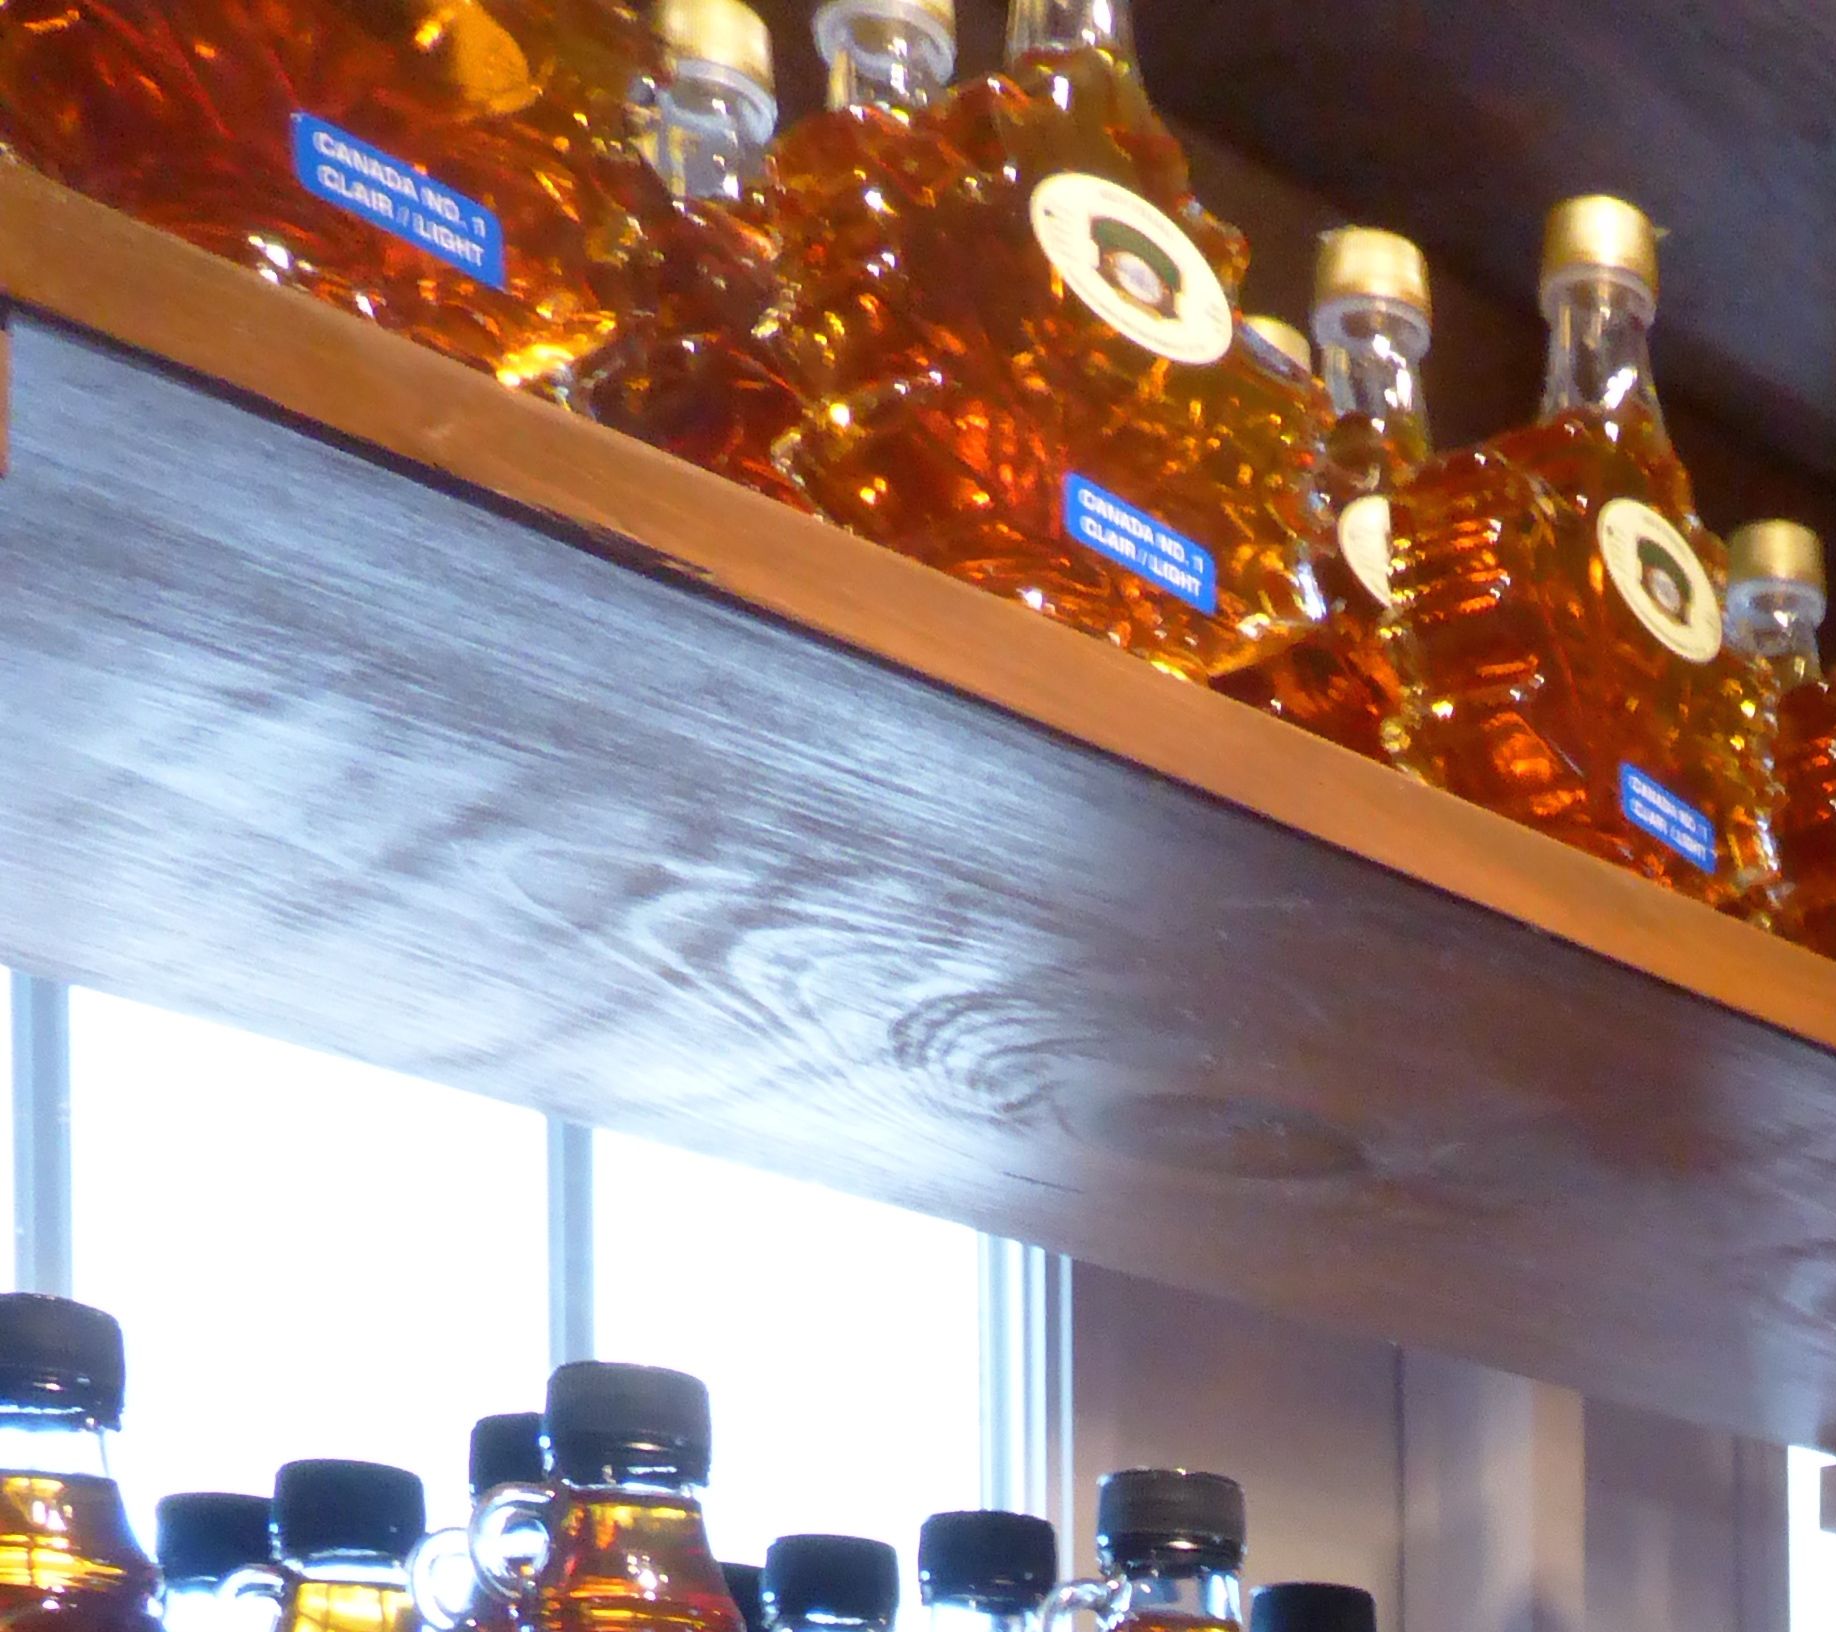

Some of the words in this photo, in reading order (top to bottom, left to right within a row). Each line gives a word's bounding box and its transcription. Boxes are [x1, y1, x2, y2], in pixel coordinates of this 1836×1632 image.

[313, 131, 419, 202] CANADA
[472, 216, 486, 238] 1
[317, 164, 395, 220] CLAIR
[412, 212, 485, 267] LIGHT
[1078, 488, 1155, 546] CANADA
[1192, 555, 1204, 574] 1
[1080, 515, 1137, 560] CLAIR
[1147, 553, 1203, 597] LIGHT
